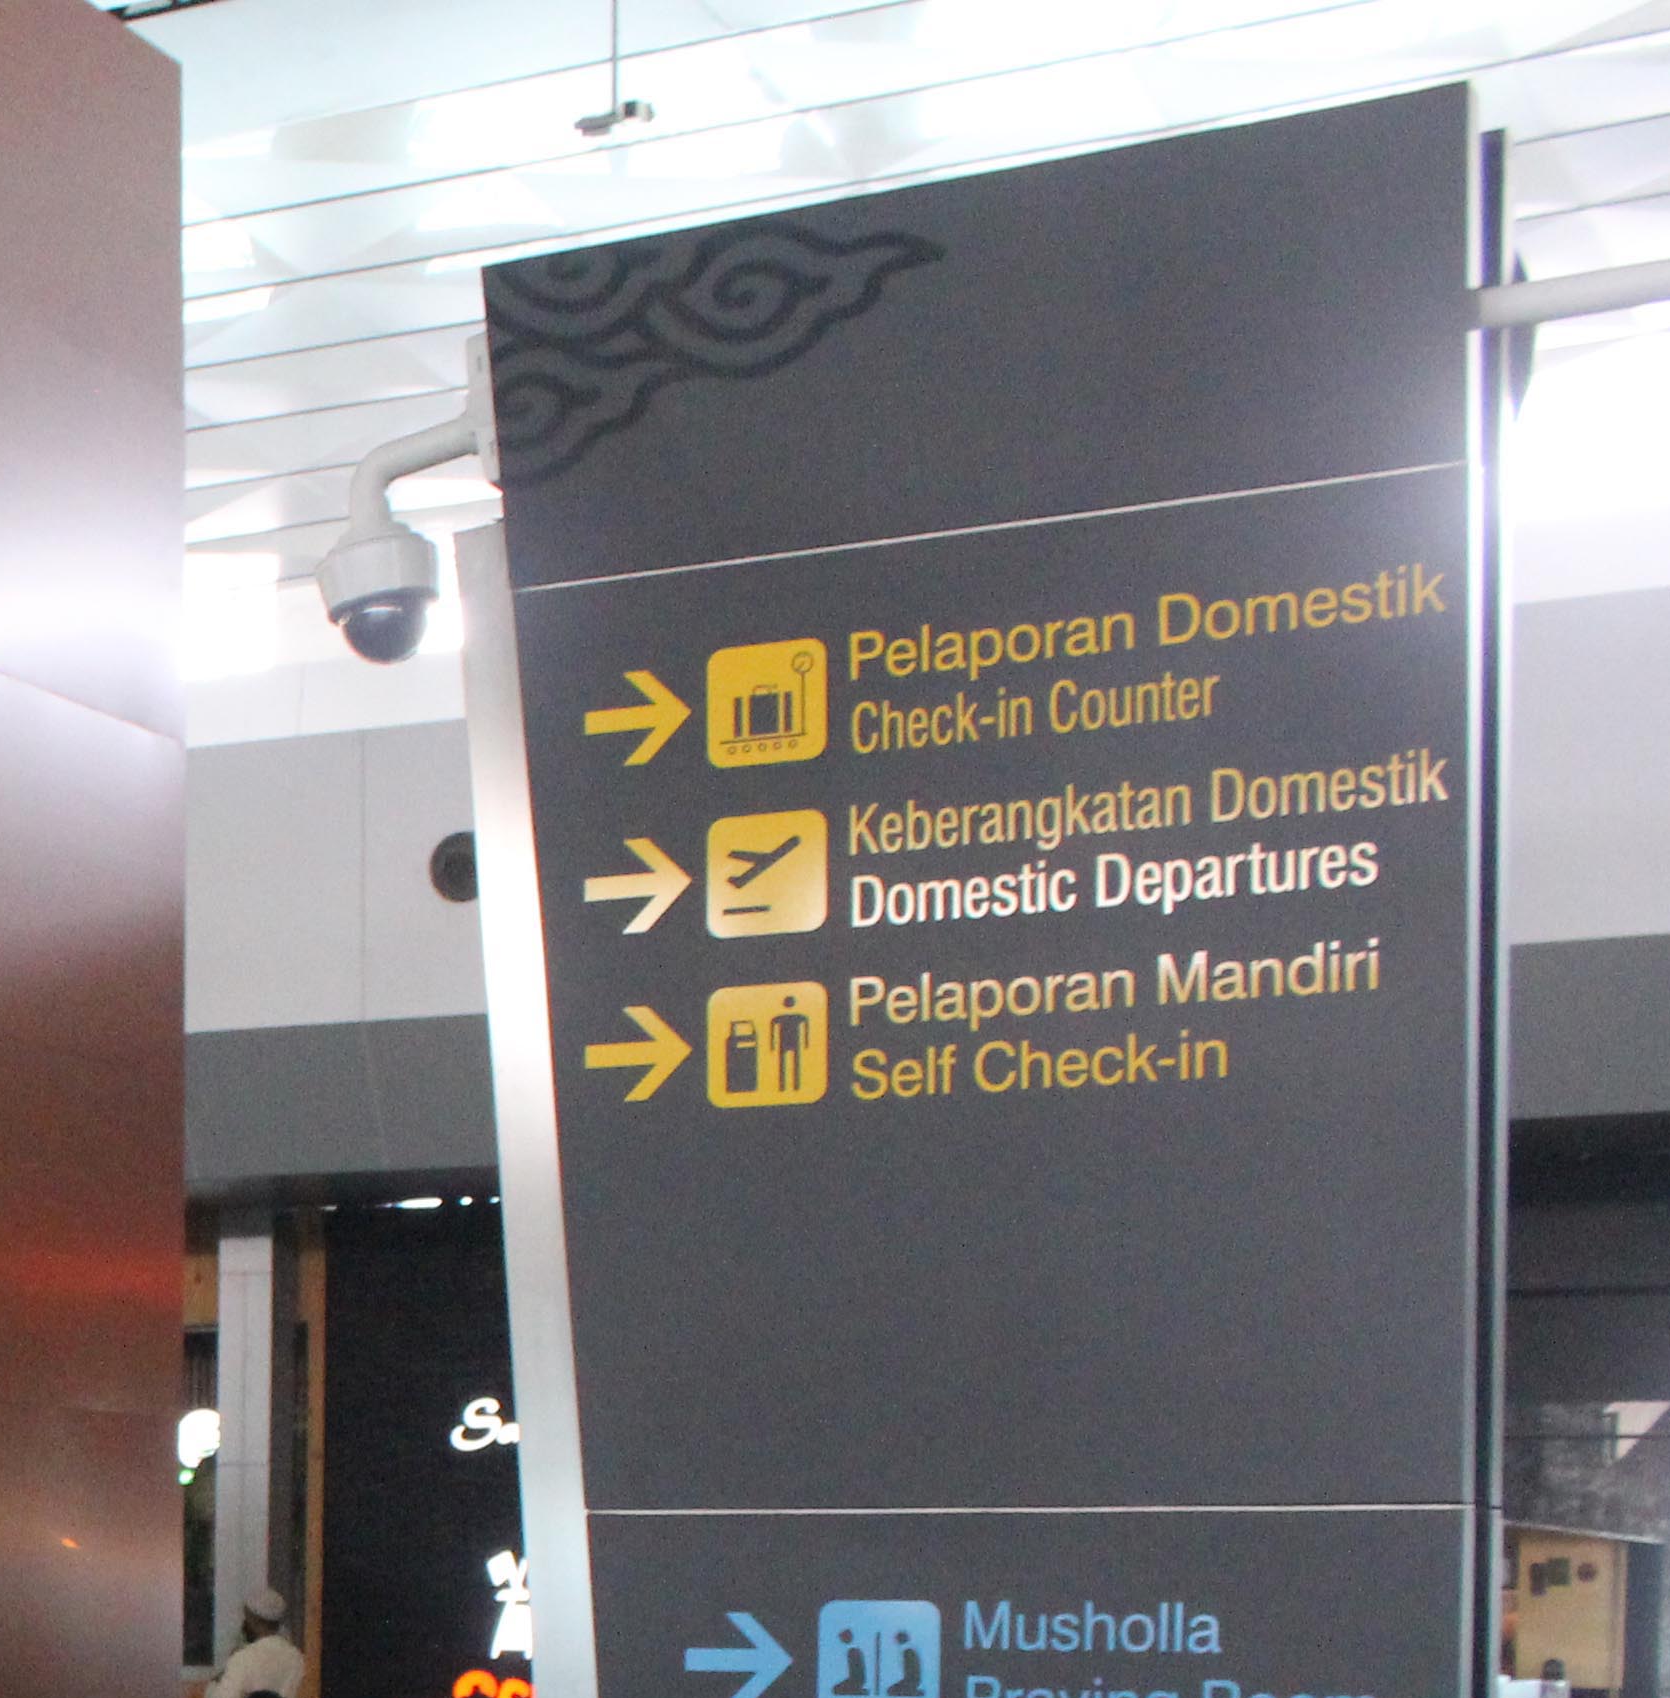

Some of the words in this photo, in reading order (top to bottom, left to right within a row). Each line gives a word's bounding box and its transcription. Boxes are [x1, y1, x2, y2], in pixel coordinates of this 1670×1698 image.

[850, 613, 1134, 680] Pelaporan
[1159, 564, 1444, 644] Domestik
[852, 688, 1032, 753] Check-in
[1050, 673, 1220, 733] Counter
[850, 782, 1192, 855] Keberangkatan
[1212, 749, 1448, 821] Domestik
[851, 860, 1077, 927] Domestic
[1096, 842, 1379, 914] Departures
[851, 970, 1135, 1031] Pelaporan
[1157, 937, 1379, 1004] Mandiri
[853, 1044, 956, 1100] Self
[975, 1030, 1228, 1092] Check-in
[964, 1600, 1221, 1653] Musholla
